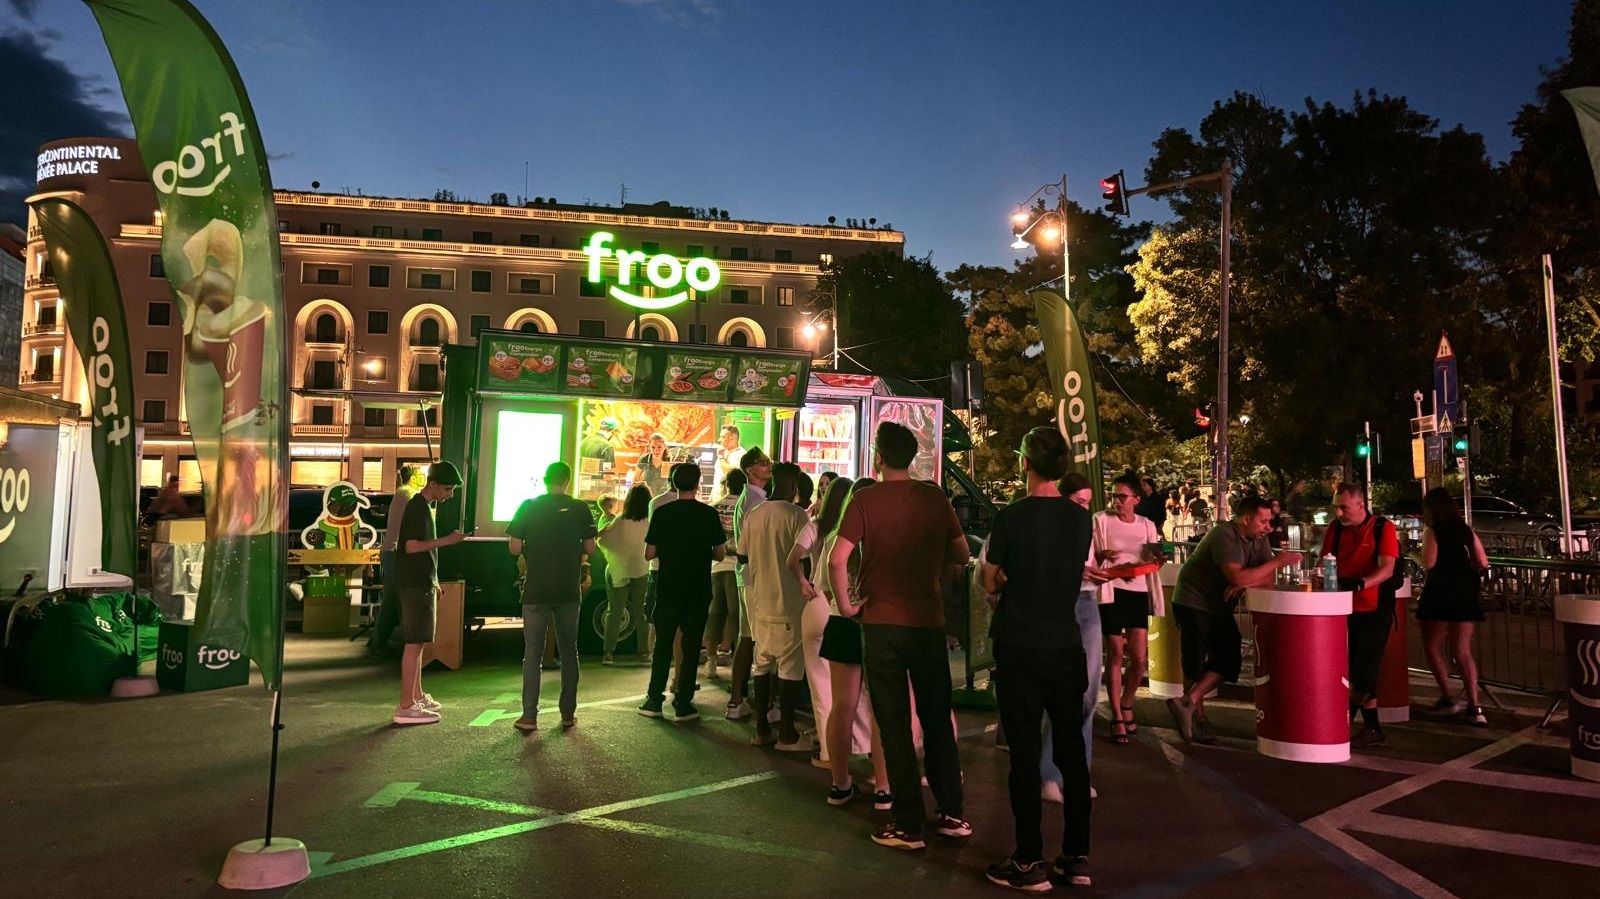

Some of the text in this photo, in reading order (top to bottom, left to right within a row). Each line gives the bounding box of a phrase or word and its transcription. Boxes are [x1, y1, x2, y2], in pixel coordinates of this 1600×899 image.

[56, 161, 98, 175] PALACE
[582, 231, 721, 292] froo
[162, 643, 183, 664] froo
[197, 645, 241, 664] froo
